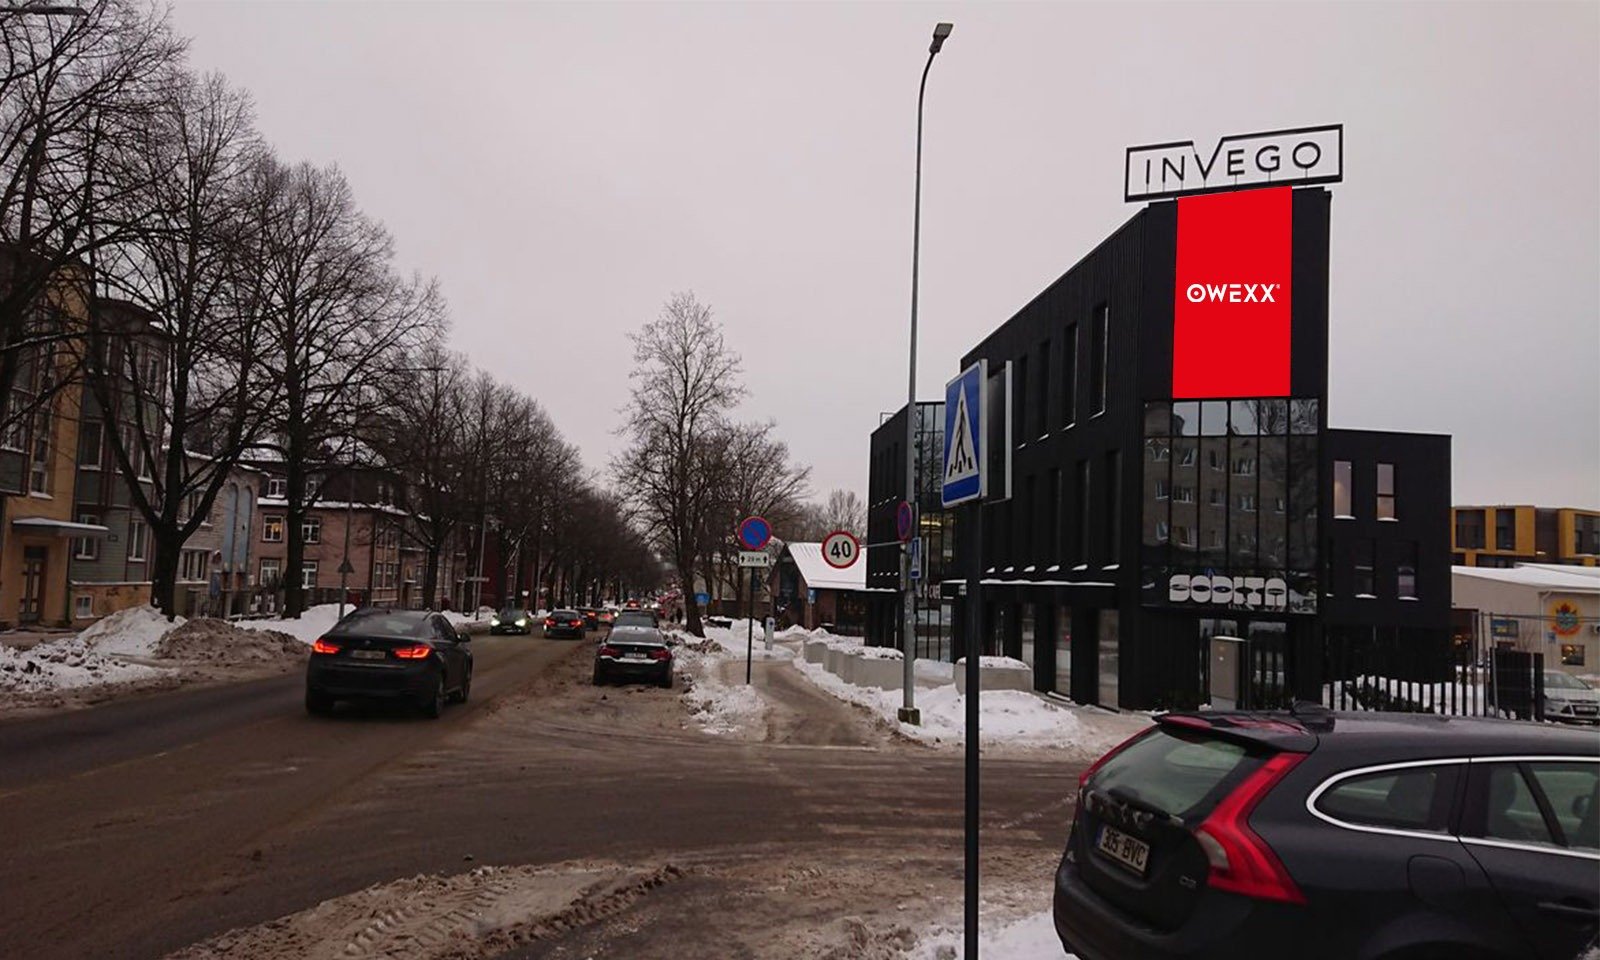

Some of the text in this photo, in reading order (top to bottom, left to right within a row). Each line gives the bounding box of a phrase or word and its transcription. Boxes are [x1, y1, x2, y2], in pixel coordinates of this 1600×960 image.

[1146, 141, 1321, 185] INVEGO
[1186, 283, 1276, 303] OWEXX
[830, 540, 852, 558] 40
